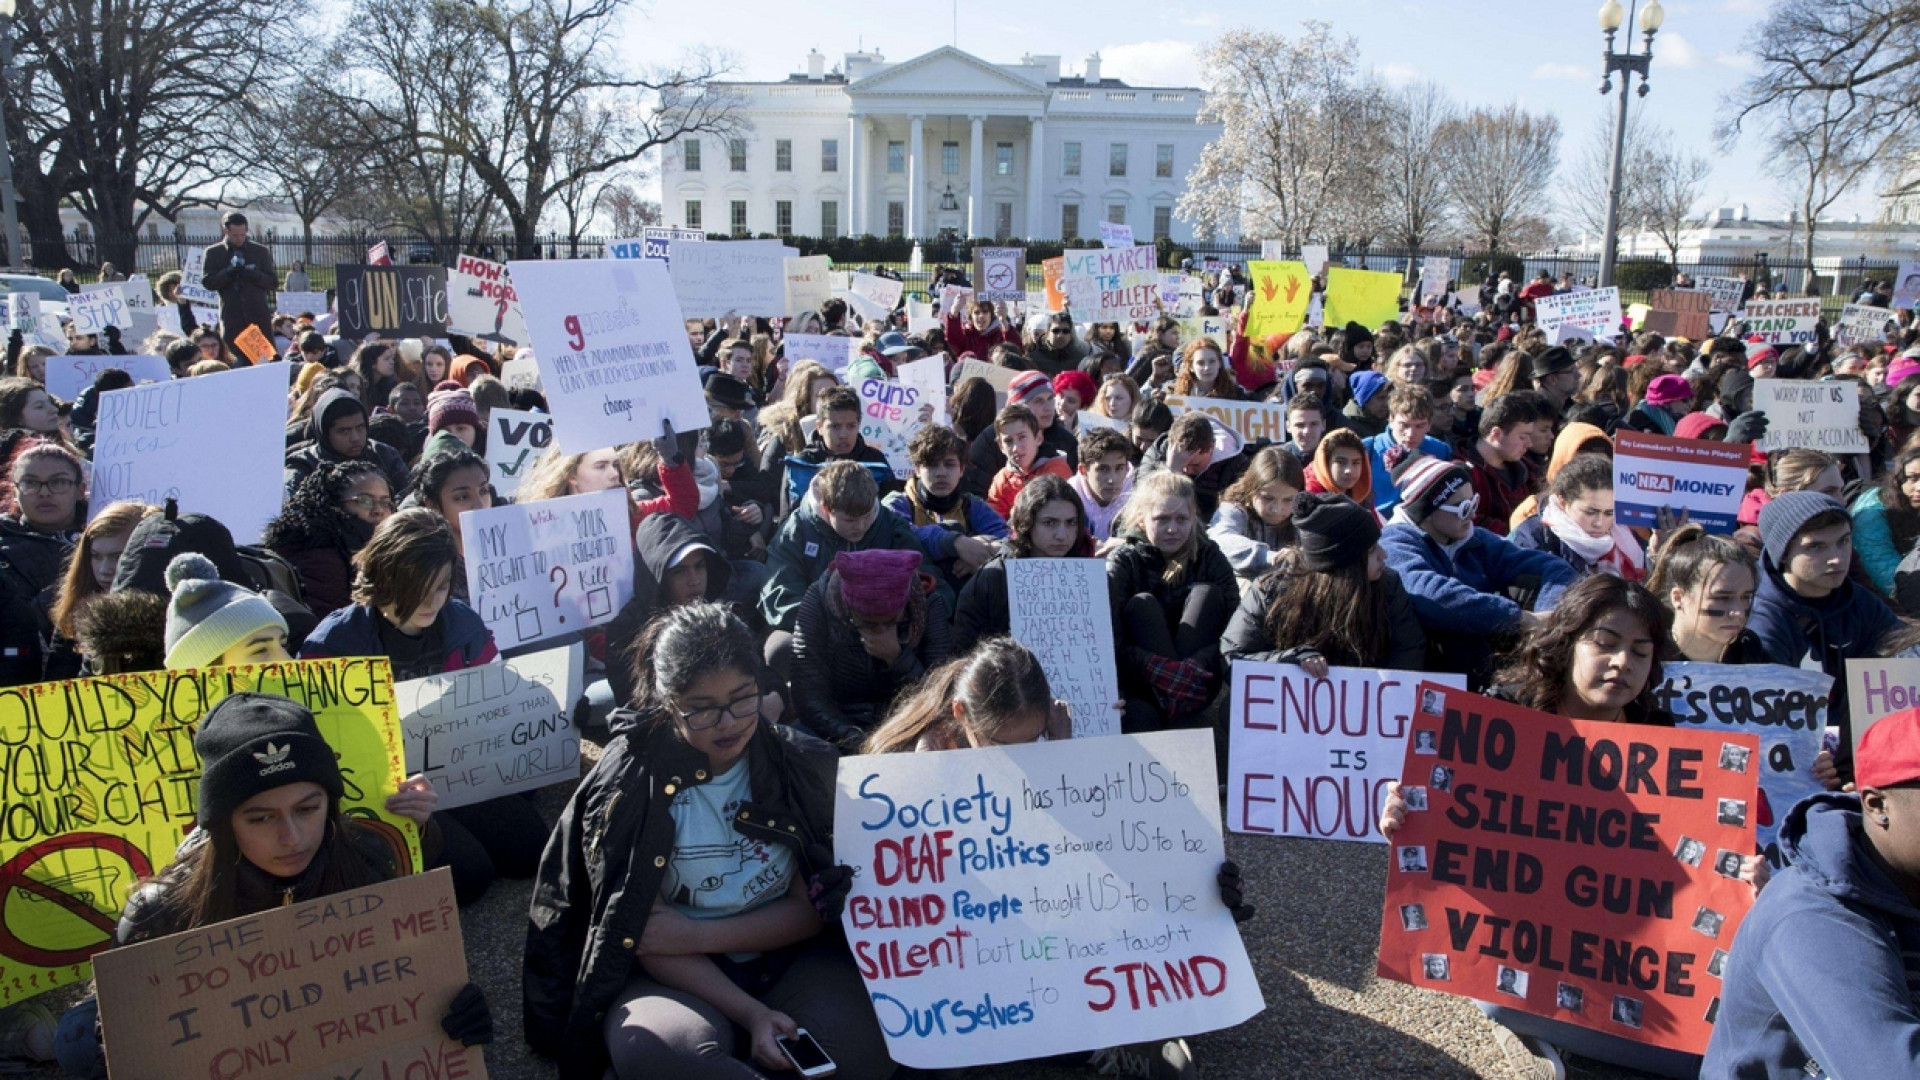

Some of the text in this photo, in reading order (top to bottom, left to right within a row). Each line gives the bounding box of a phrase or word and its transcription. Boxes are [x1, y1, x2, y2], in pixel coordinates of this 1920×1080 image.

[647, 230, 704, 241] APARTMENTS
[982, 249, 1020, 258] No Guns
[1066, 255, 1096, 275] WE
[1100, 245, 1156, 274] MARCH
[458, 257, 502, 282] HOW
[1702, 277, 1710, 288] I
[1068, 274, 1121, 295] FOR THE
[1101, 284, 1158, 309] BULLETS
[1745, 302, 1819, 318] TEACHERS
[1746, 318, 1797, 331] STAND
[1744, 331, 1817, 343] WTH YOU
[99, 383, 186, 431] PROTECT
[861, 379, 919, 406] Guns
[1773, 387, 1844, 403] WORRY ABOUT US
[866, 402, 902, 421] are
[1798, 411, 1814, 424] NOT
[497, 418, 553, 449] VO
[1788, 428, 1868, 446] BANK ACCOUNTS
[1620, 439, 1742, 459] Hey Lawmakers! Take the Pledge!
[93, 461, 135, 499] NOT
[1620, 472, 1735, 497] NO NRA MONEY
[571, 508, 608, 539] YOUR
[478, 523, 508, 560] MY
[571, 536, 618, 565] RIGHT TO
[478, 551, 547, 591] RIGHT TO
[579, 565, 613, 590] Kill
[1014, 560, 1058, 574] ALYSSA
[1014, 573, 1055, 589] SCOTT
[1075, 574, 1088, 587] 35
[478, 593, 528, 622] Live
[550, 565, 568, 624] ?
[1020, 617, 1065, 633] JAMIE
[1020, 632, 1064, 647] CHRIS
[1085, 647, 1100, 663] 15
[1090, 667, 1103, 682] 14
[0, 682, 137, 746] OULD
[256, 659, 390, 710] CHANGE
[416, 664, 521, 719] CHILD
[528, 673, 555, 690] IS
[1092, 686, 1108, 700] 14
[1655, 675, 1829, 731] t's easier
[407, 695, 550, 741] WORTH MORE THAN
[450, 744, 468, 764] OF
[474, 733, 506, 756] THE
[511, 711, 571, 746] GUNS
[258, 759, 297, 778] adidas
[429, 738, 579, 793] THE WORLD
[1330, 749, 1368, 770] IS
[1437, 709, 1704, 799] NO MORE
[1768, 744, 1795, 773] a
[858, 761, 1190, 836] Society has taught US to
[1243, 774, 1398, 837] ENOU
[1446, 784, 1661, 852] SILENCE
[873, 821, 1207, 886] DEAF Politics showed US to be
[743, 863, 783, 899] PEACE
[1431, 841, 1675, 920] END GUN
[849, 873, 1197, 929] BLIND People taught US to be
[173, 893, 385, 966] SHE SAID
[237, 948, 302, 987] YOU
[309, 926, 375, 961] LOVE
[976, 938, 1014, 966] but
[1020, 936, 1060, 961] WE
[1065, 937, 1109, 960] have
[1117, 924, 1191, 954] taught
[1445, 907, 1697, 998] VIOLENCE
[167, 955, 418, 1047] I TOLD HER
[869, 955, 1229, 1039] Ourselves to STAND
[208, 992, 426, 1080] ONLY PARTLY
